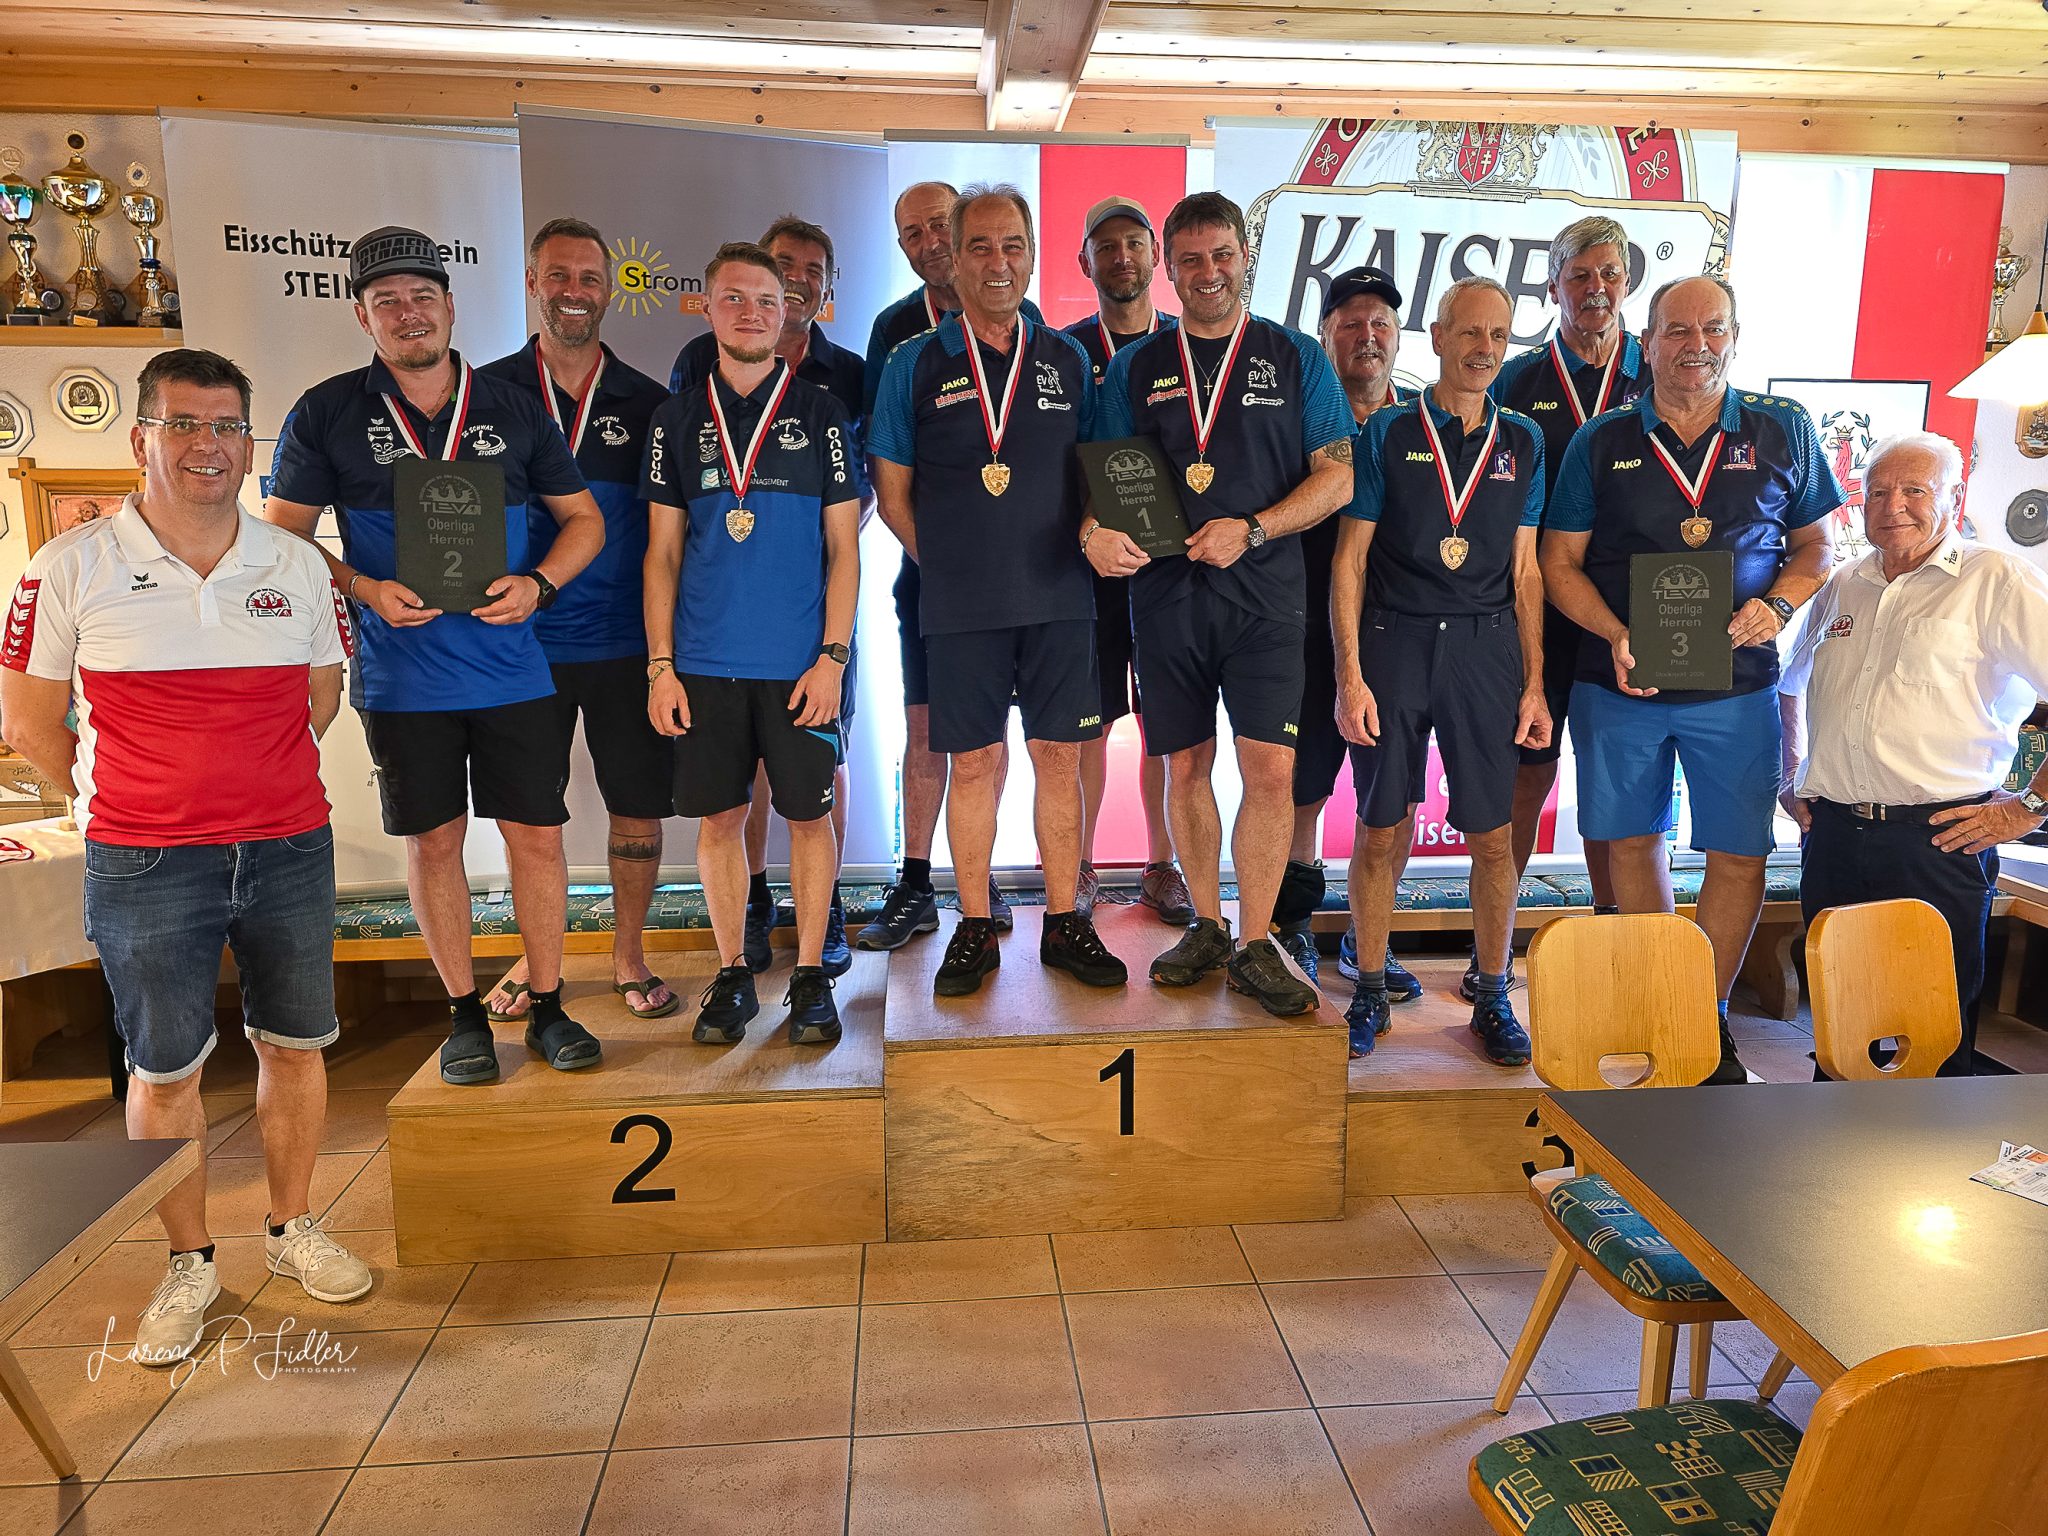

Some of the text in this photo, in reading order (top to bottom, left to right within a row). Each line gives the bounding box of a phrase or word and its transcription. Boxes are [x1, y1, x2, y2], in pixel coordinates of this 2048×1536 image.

[941, 376, 969, 392] JAKO
[1152, 375, 1179, 389] JAKO
[1532, 401, 1558, 410] JAKO
[1405, 451, 1435, 463] JAKO
[1612, 458, 1643, 471] JAKO
[1115, 482, 1155, 495] Oberliga
[1120, 495, 1157, 506] Herren
[1137, 507, 1152, 530] 1
[427, 517, 476, 535] Oberliga
[428, 533, 475, 546] Herren
[443, 550, 463, 578] 2
[131, 581, 158, 592] erima
[1658, 603, 1703, 617] Oberliga
[1659, 618, 1702, 628] Herren
[1671, 632, 1689, 657] 3
[1078, 714, 1101, 728] JAKO
[1283, 722, 1299, 737] JAK
[1099, 1048, 1135, 1136] 1
[610, 1113, 676, 1204] 2
